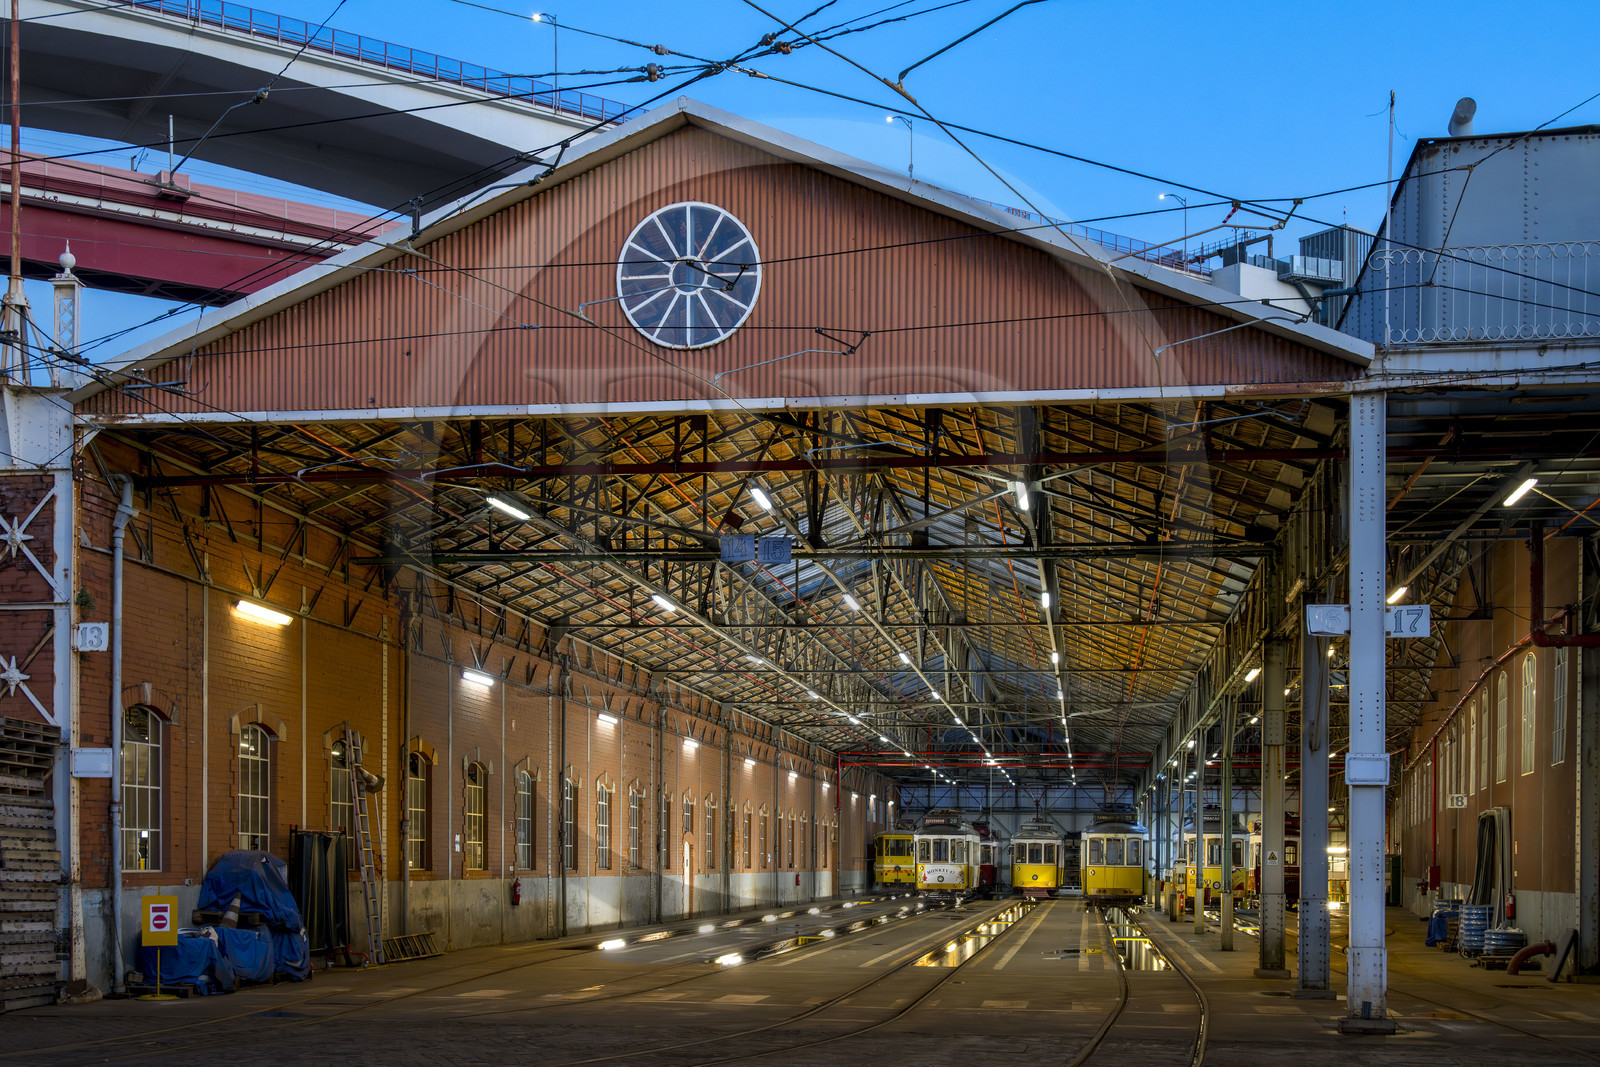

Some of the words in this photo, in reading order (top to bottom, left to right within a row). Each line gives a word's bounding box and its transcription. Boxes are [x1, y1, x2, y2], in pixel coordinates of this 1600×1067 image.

[727, 537, 748, 558] 14
[763, 540, 785, 561] 15
[1315, 608, 1342, 632] 16
[1393, 608, 1424, 634] 17
[79, 626, 103, 649] 13
[1449, 795, 1465, 807] 18
